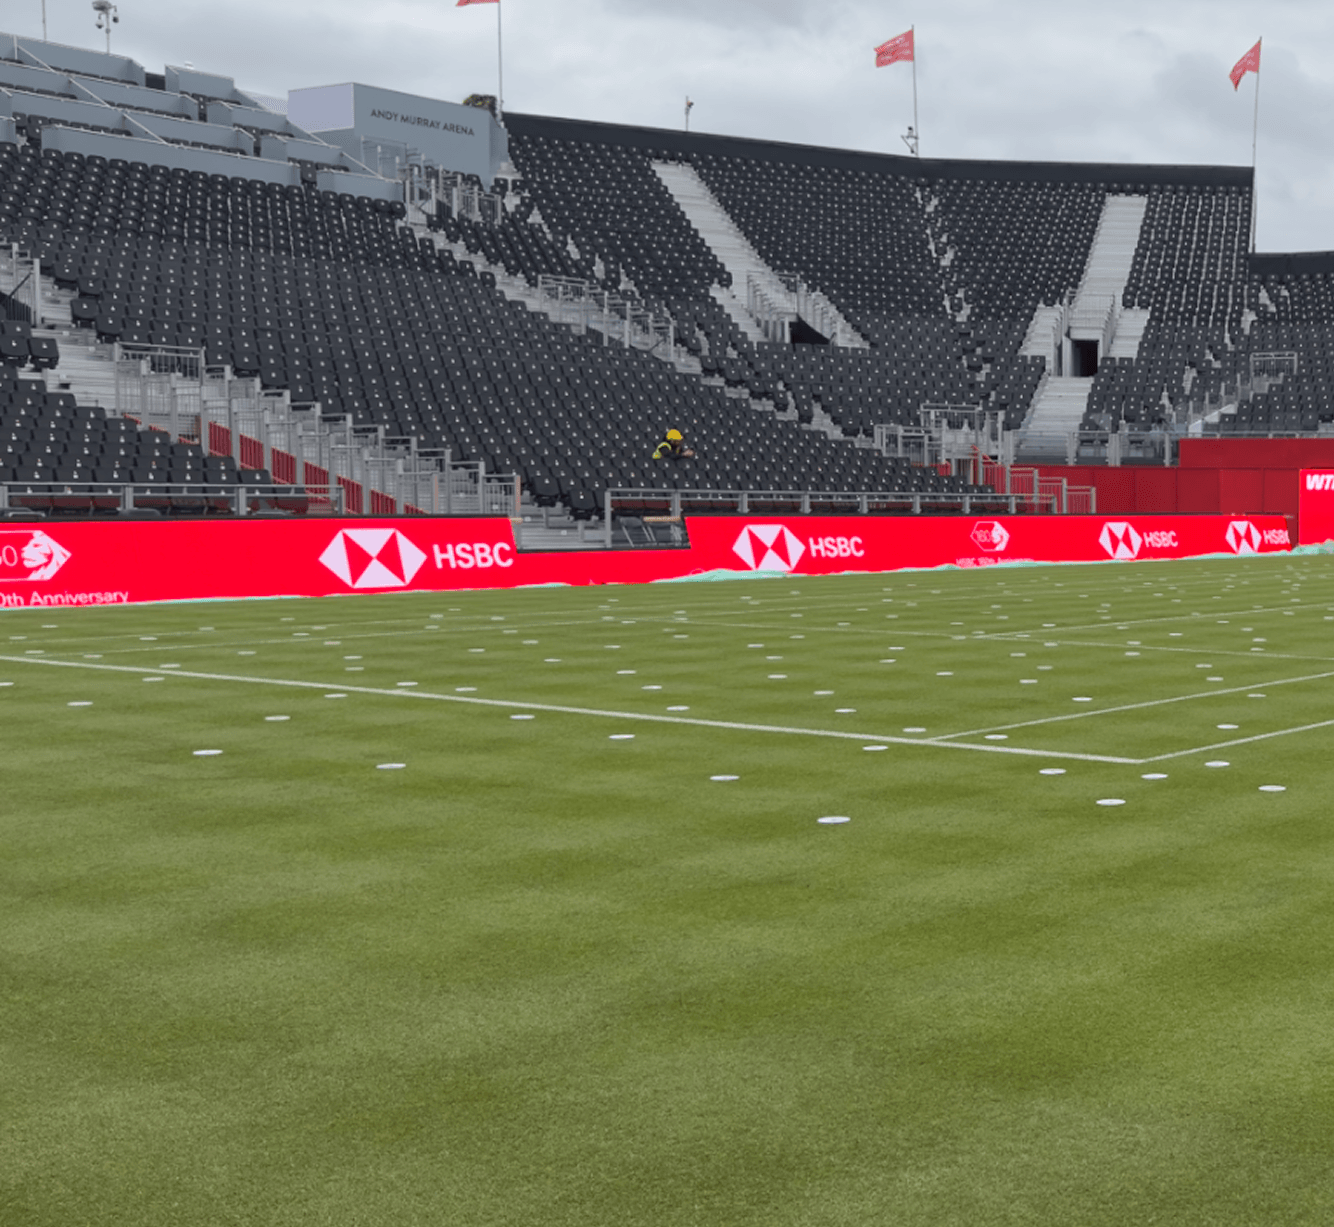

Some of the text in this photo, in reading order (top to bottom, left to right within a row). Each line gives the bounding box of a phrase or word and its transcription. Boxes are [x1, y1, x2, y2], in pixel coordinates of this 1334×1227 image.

[370, 108, 475, 136] ANDY MURRAY ARENA
[808, 536, 865, 558] HSBC
[1143, 530, 1179, 548] HSBC
[432, 542, 514, 569] HSBC
[30, 591, 130, 606] Anniversary
